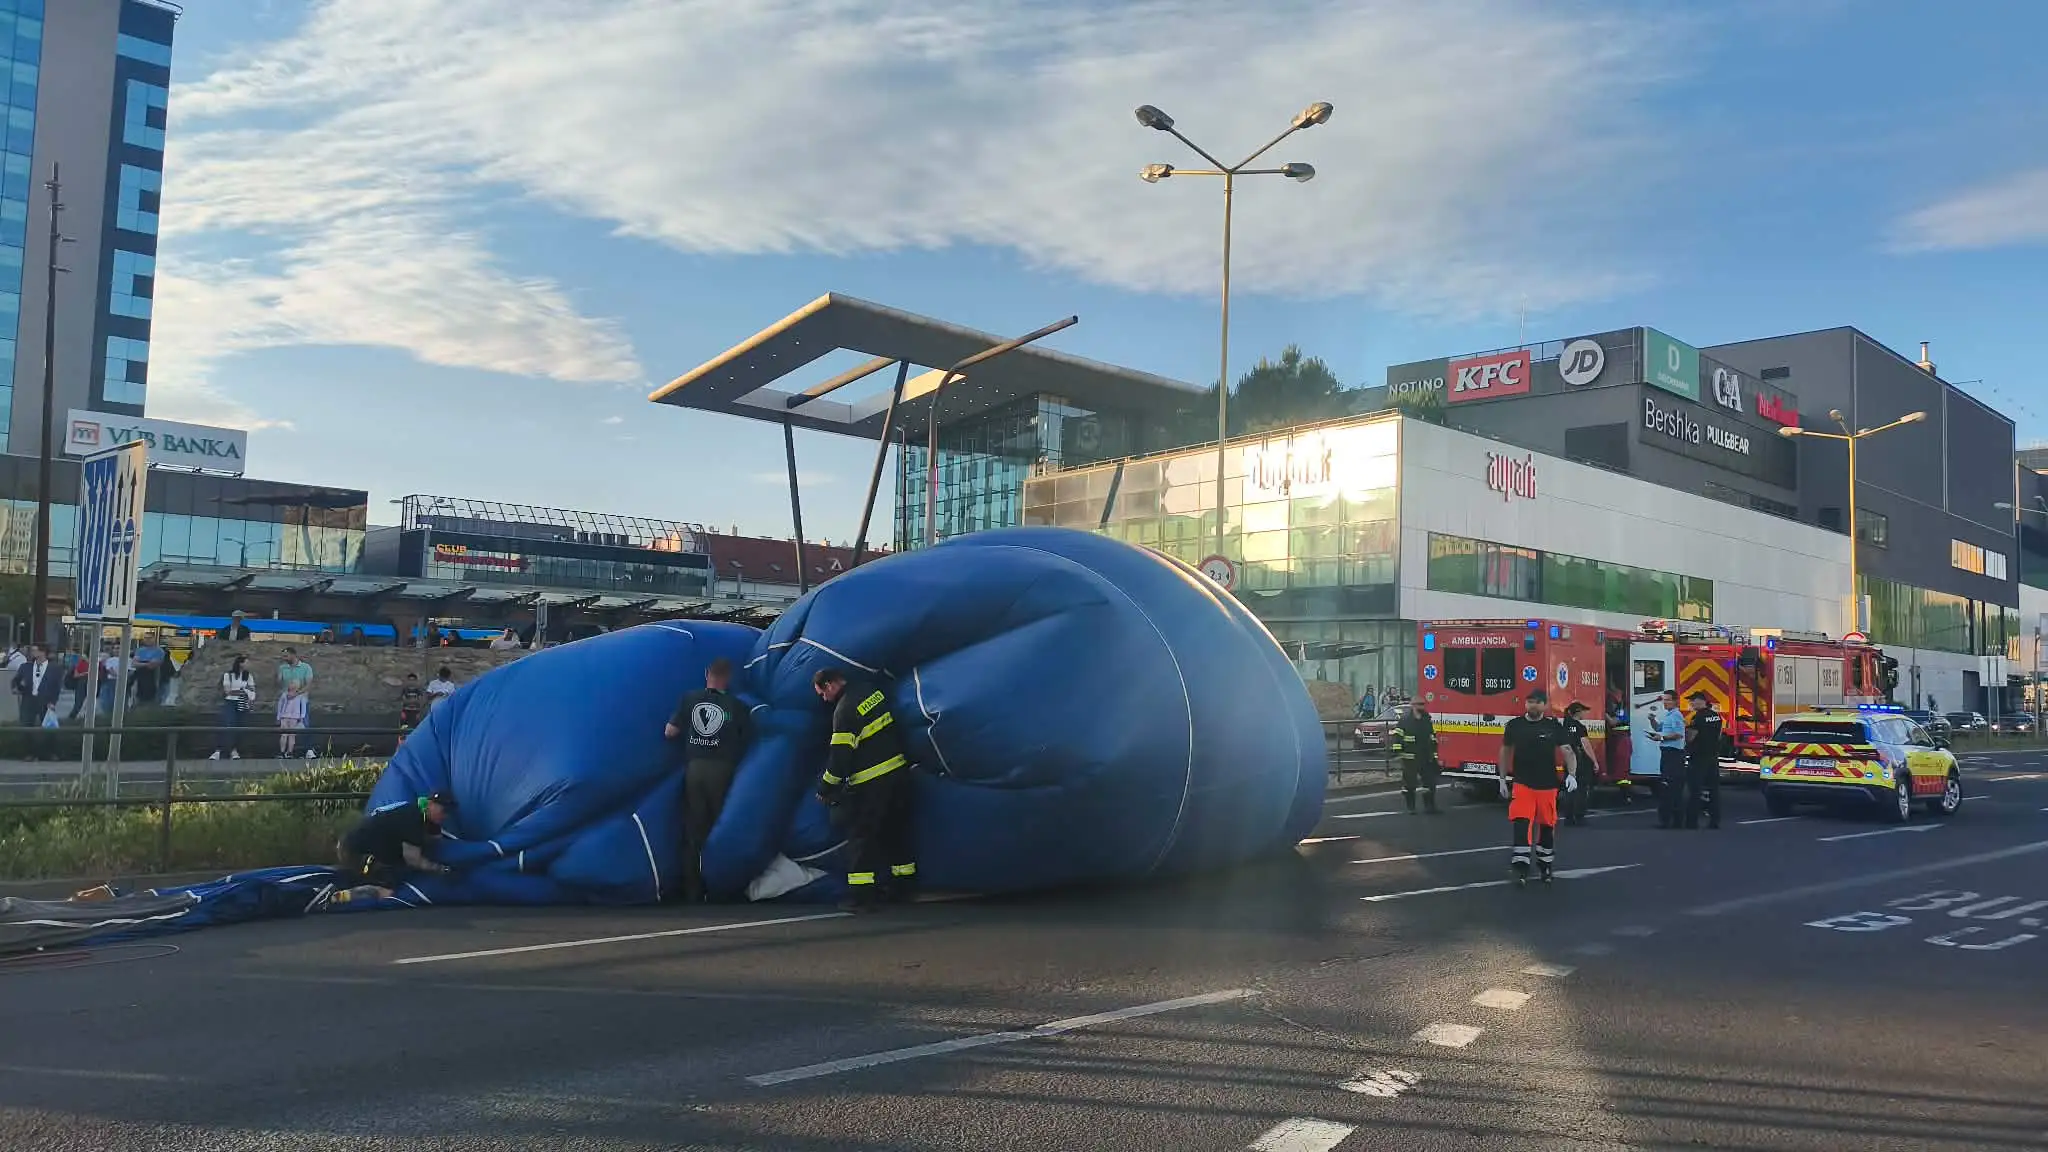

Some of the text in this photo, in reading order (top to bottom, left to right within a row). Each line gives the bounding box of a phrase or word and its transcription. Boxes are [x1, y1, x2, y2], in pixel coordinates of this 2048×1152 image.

[1564, 349, 1599, 375] JD
[1668, 344, 1680, 371] D
[1389, 377, 1445, 395] NOTINO
[1454, 359, 1522, 392] KFC
[1712, 367, 1744, 413] C&A
[1645, 398, 1700, 445] Bershka
[106, 426, 240, 459] VÚB BANKA
[1707, 424, 1750, 456] PULL&BEAR
[1486, 451, 1537, 502] aupark
[1451, 636, 1507, 645] AMBULANCIA
[1458, 678, 1470, 688] 150
[1485, 678, 1511, 689] SOS 112
[1581, 671, 1591, 687] SOS
